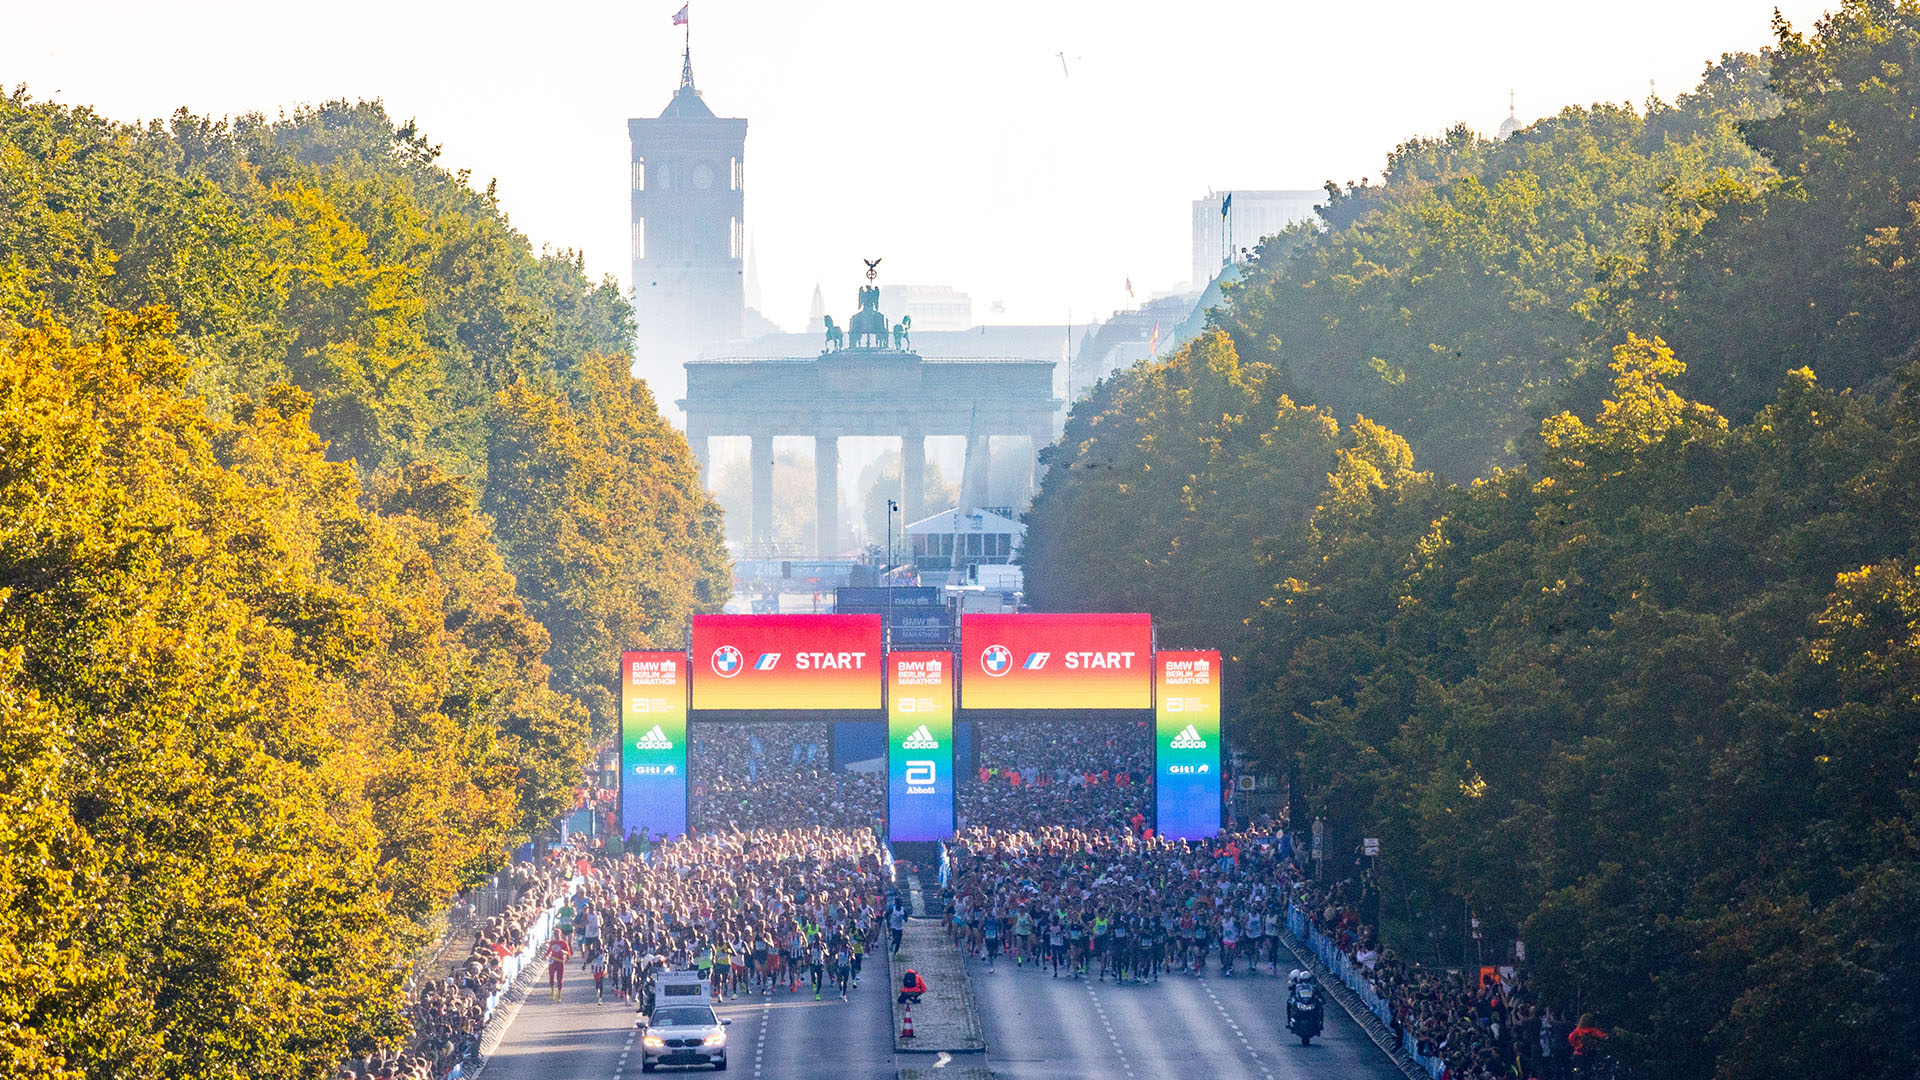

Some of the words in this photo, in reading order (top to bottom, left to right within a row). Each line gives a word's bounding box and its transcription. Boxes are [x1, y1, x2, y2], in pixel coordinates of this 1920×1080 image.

[903, 617, 925, 626] BMW
[796, 652, 866, 669] START
[1065, 652, 1135, 669] START
[632, 662, 659, 671] BMW
[898, 661, 925, 671] BMW
[1166, 661, 1193, 670] BMW
[1166, 677, 1210, 685] MARATHON
[637, 740, 673, 749] adidas
[902, 740, 939, 749] adidas
[1170, 739, 1207, 749] adidas
[906, 786, 936, 794] Abbott
